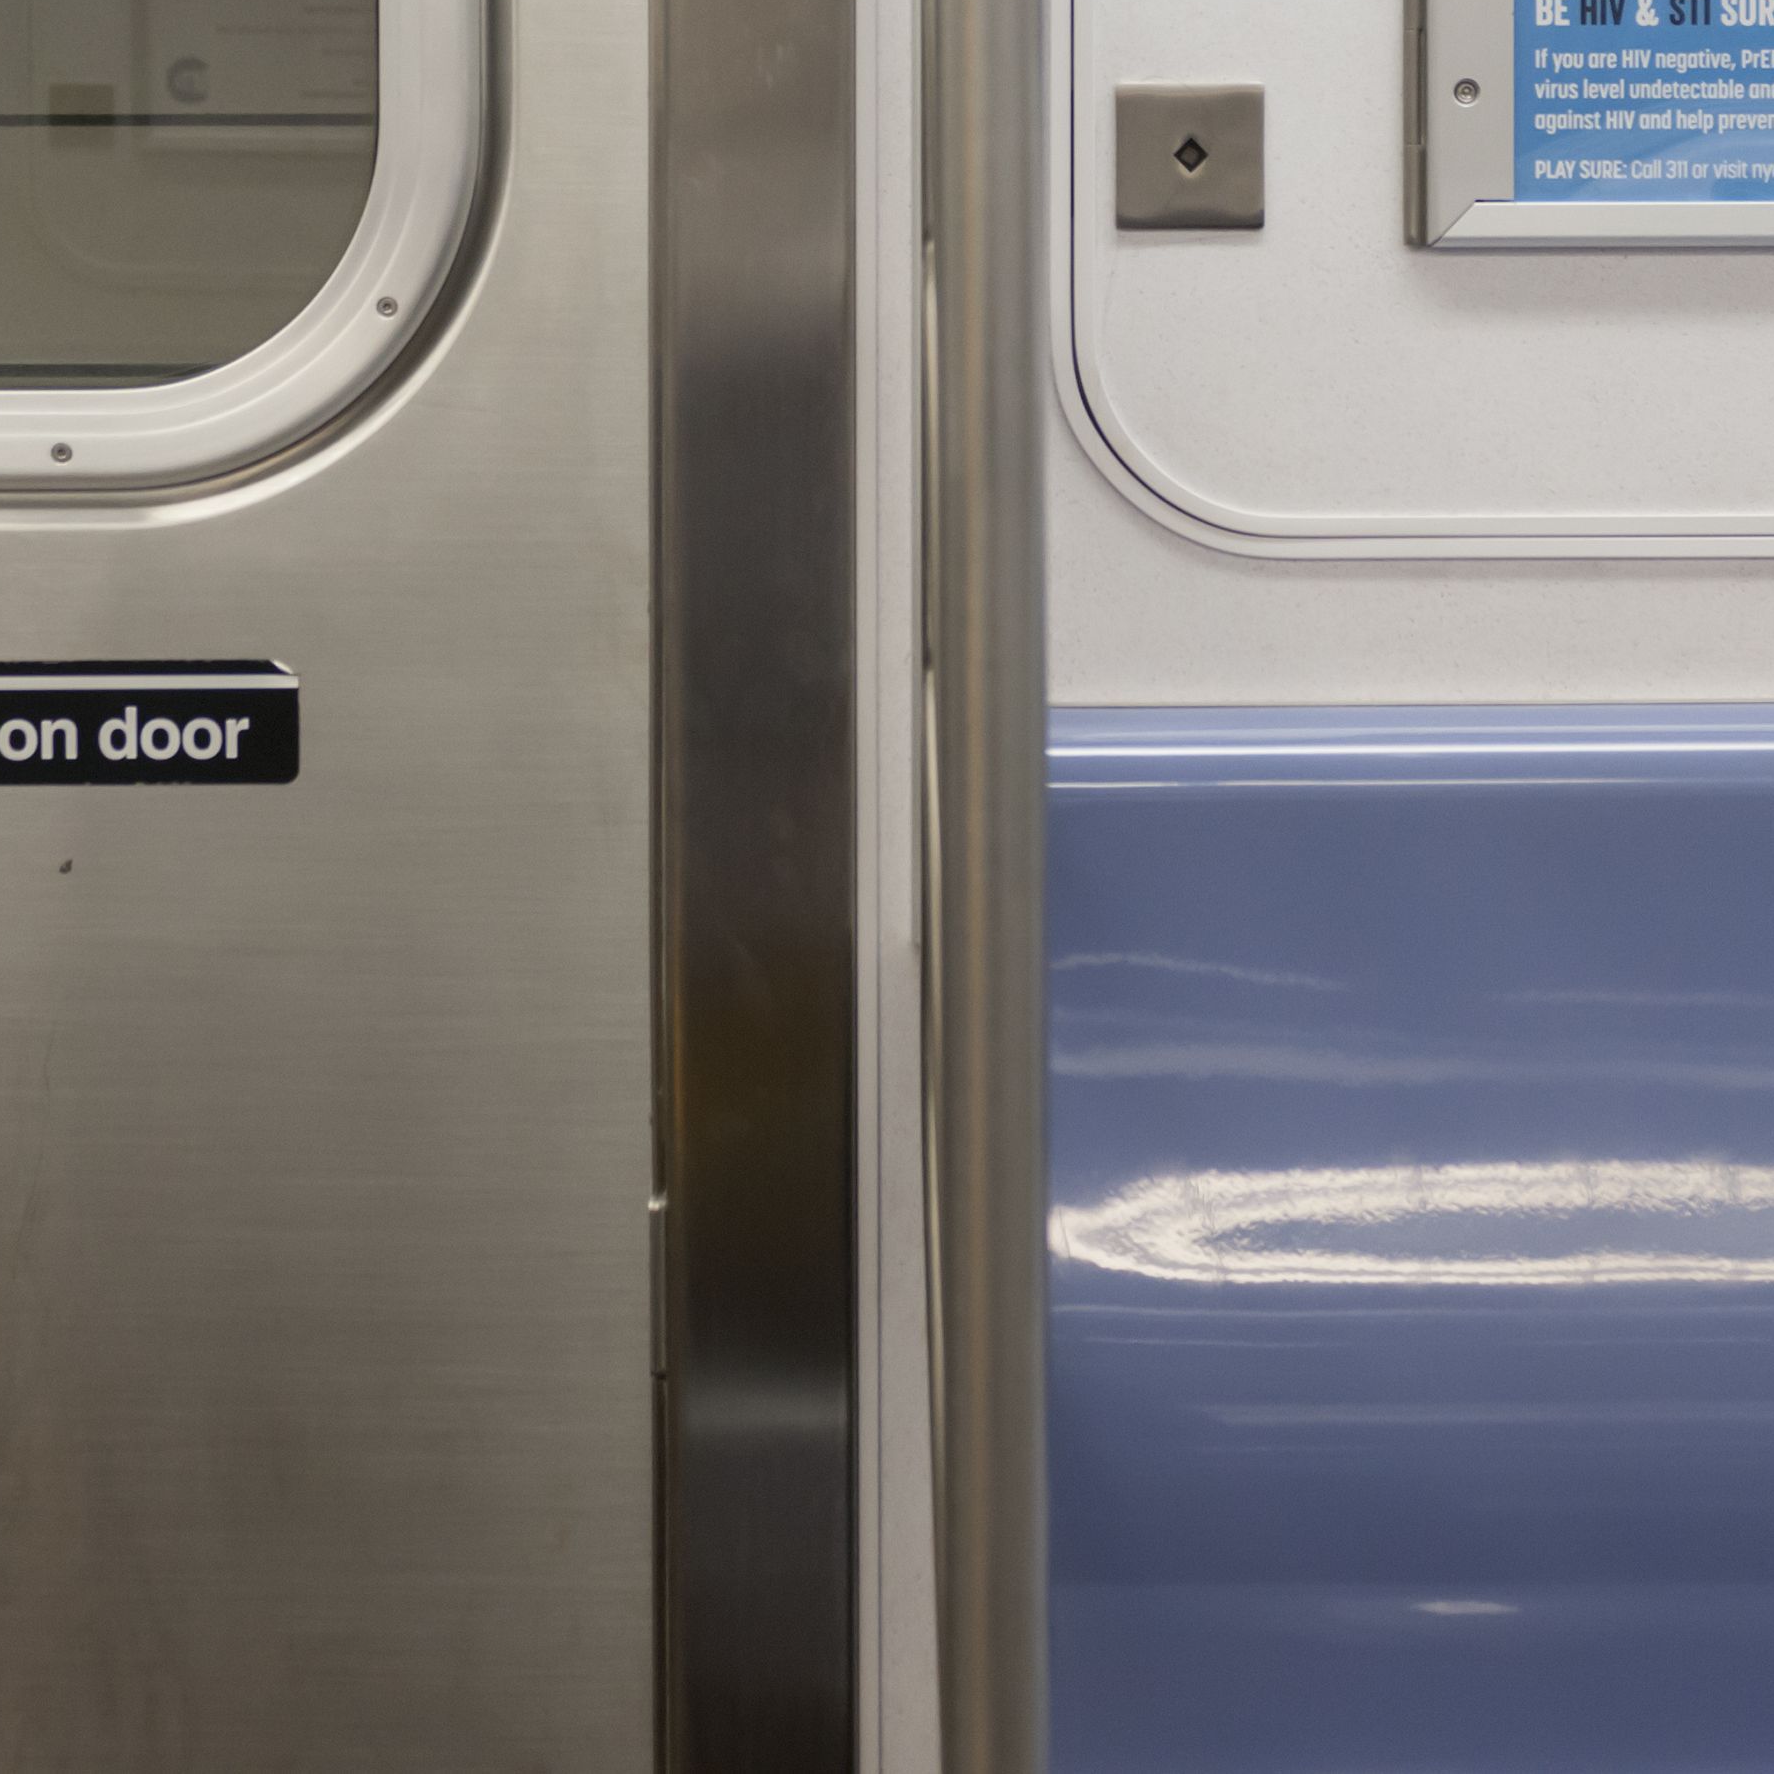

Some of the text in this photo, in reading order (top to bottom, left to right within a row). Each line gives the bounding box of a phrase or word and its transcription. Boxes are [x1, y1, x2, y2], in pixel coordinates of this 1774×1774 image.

[1535, 48, 1549, 70] If
[1552, 53, 1584, 74] you
[1587, 53, 1618, 70] are
[1622, 48, 1652, 70] HIV
[1655, 48, 1737, 74] negative,
[1534, 79, 1579, 100] virus
[1583, 79, 1625, 100] level
[1629, 79, 1745, 100] undetectable
[1534, 109, 1602, 135] against
[1605, 109, 1636, 130] HIV
[1639, 109, 1673, 130] and
[1676, 109, 1714, 135] help
[1534, 159, 1576, 180] PLAY
[1579, 159, 1629, 180] SURE:
[1630, 159, 1663, 180] Call
[1665, 159, 1690, 180] 311
[1692, 164, 1711, 180] or
[1712, 159, 1749, 180] visit
[97, 705, 251, 761] door
